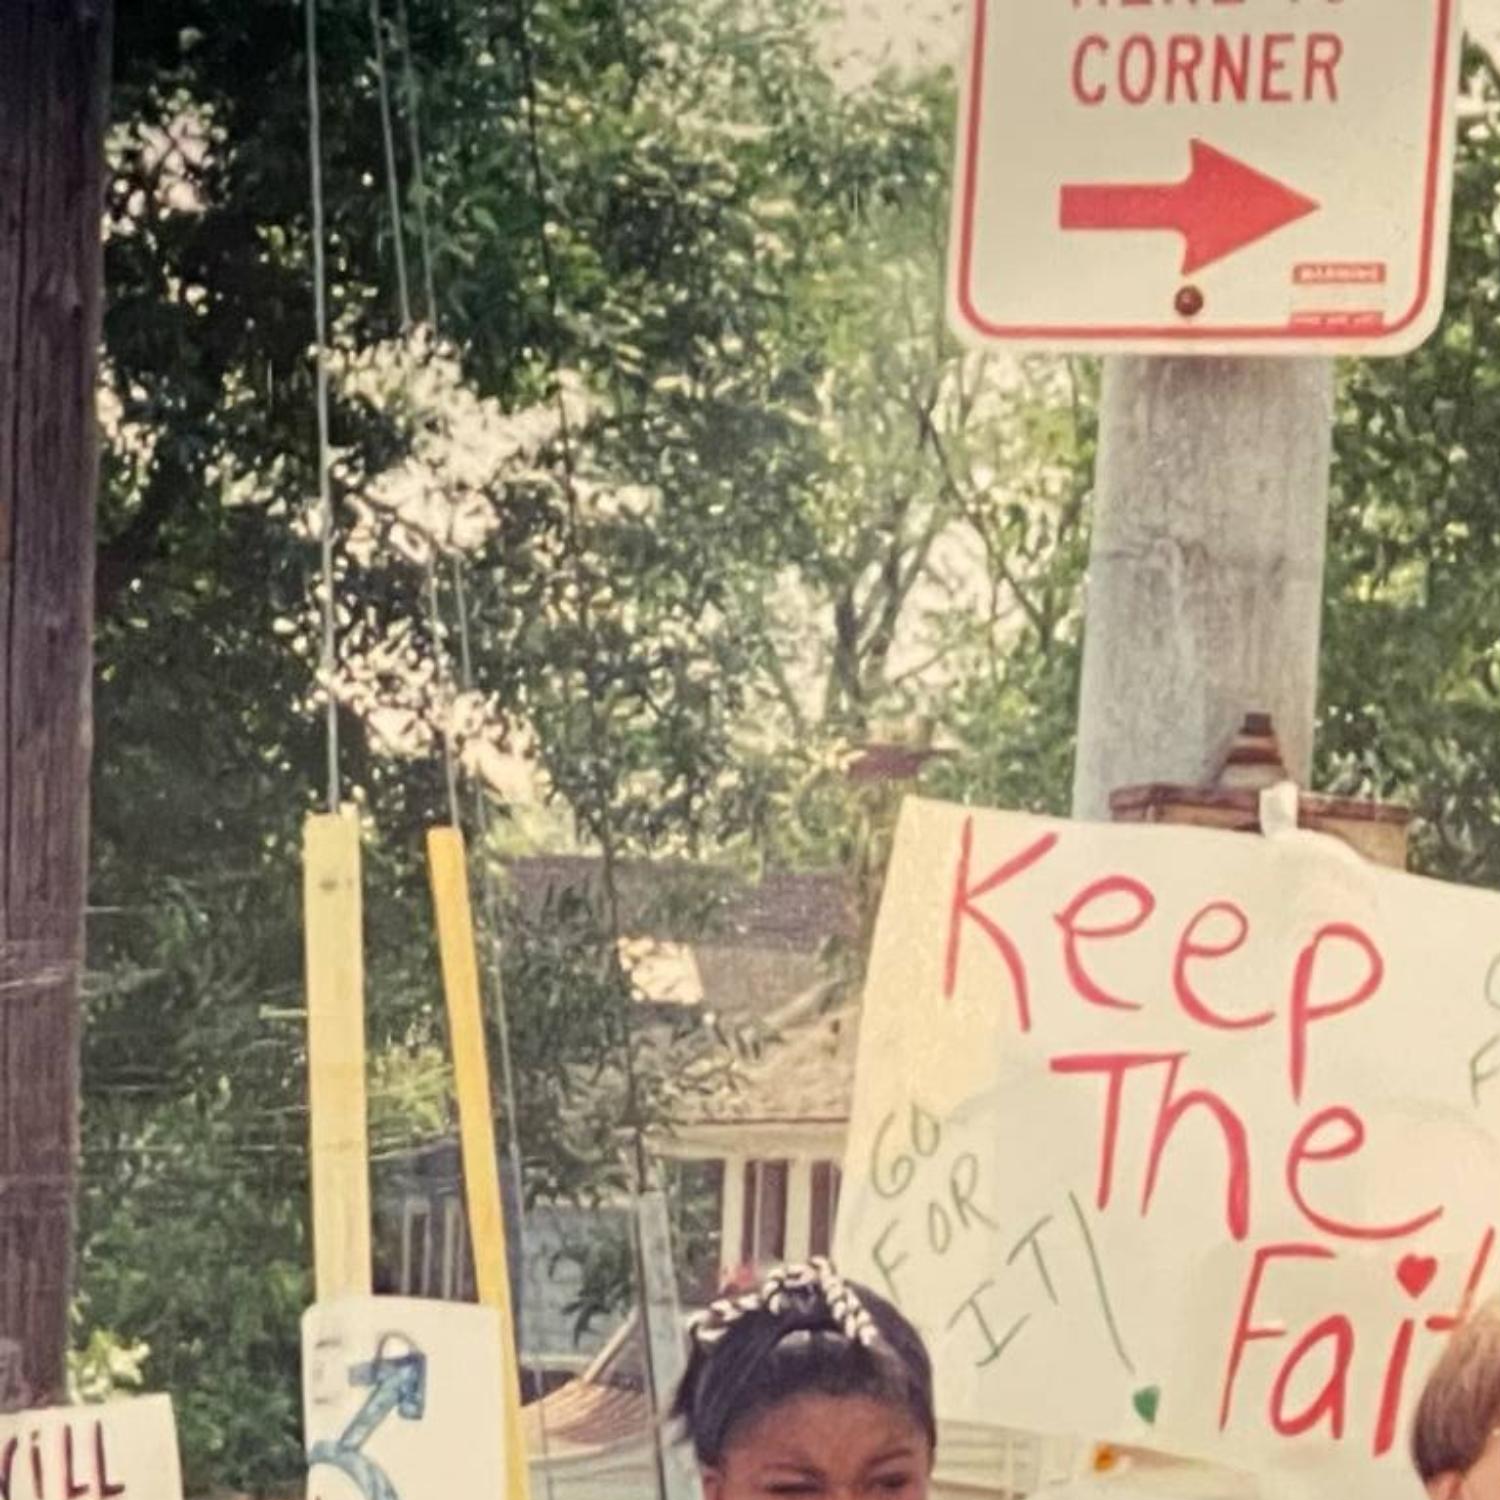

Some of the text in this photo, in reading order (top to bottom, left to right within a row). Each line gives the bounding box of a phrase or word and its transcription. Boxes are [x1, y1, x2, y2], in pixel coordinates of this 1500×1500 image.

[1072, 34, 1343, 105] CORNER
[943, 816, 1384, 1103] Keep
[870, 1101, 941, 1199] GO
[1050, 1051, 1444, 1241] The
[871, 1152, 999, 1304] FOR
